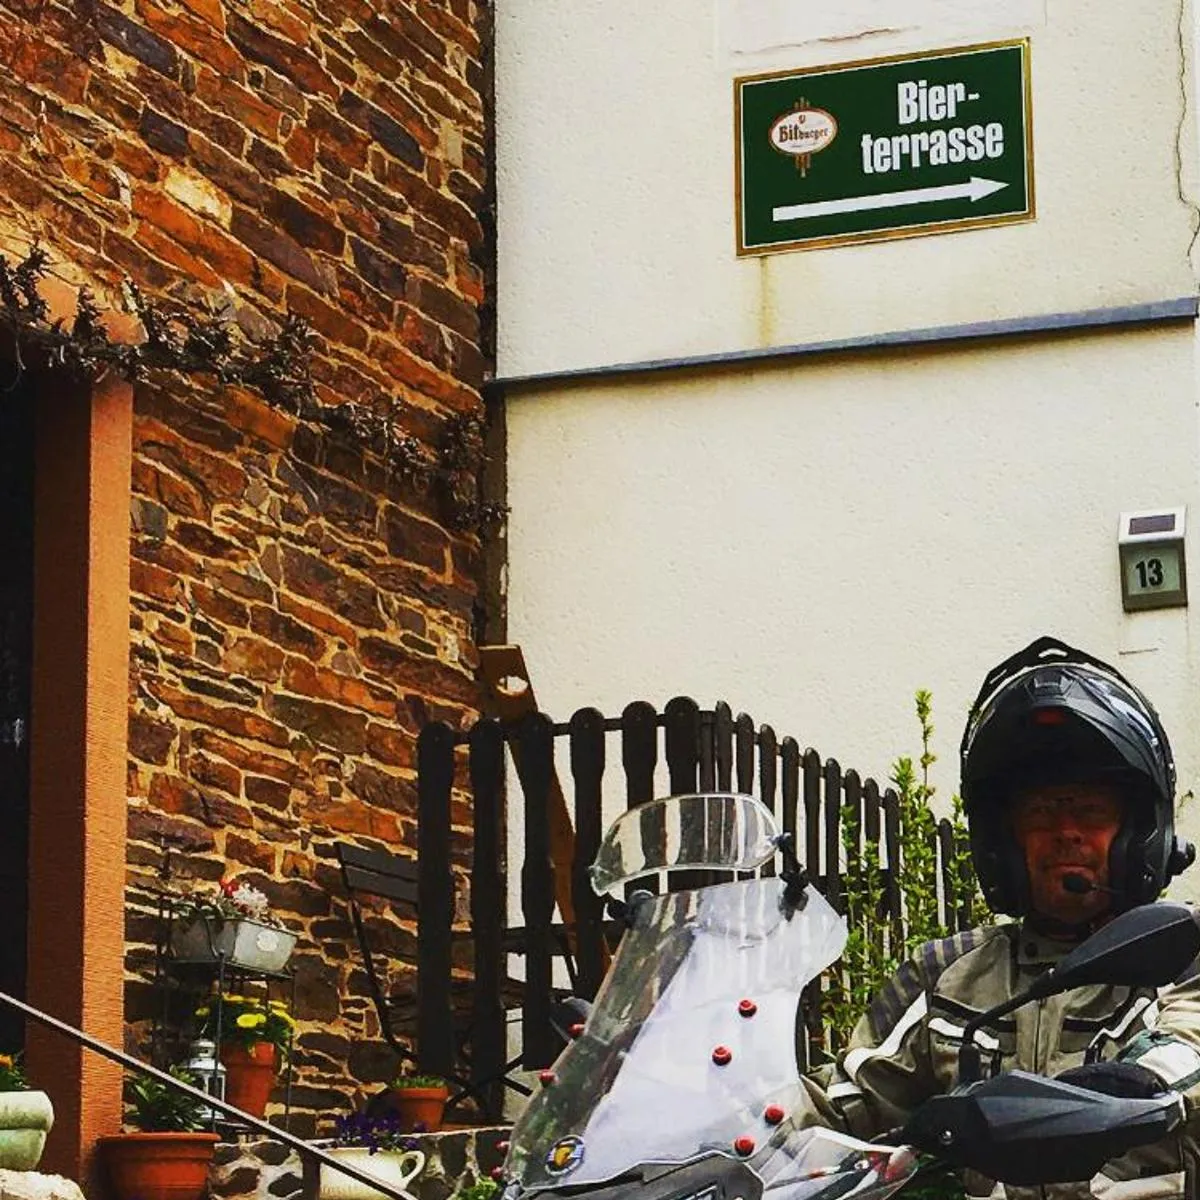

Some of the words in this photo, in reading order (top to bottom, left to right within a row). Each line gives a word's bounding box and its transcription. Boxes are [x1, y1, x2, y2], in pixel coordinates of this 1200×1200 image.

[897, 80, 979, 124] Bier-
[861, 122, 1004, 174] terrasse
[1136, 558, 1164, 588] 13
